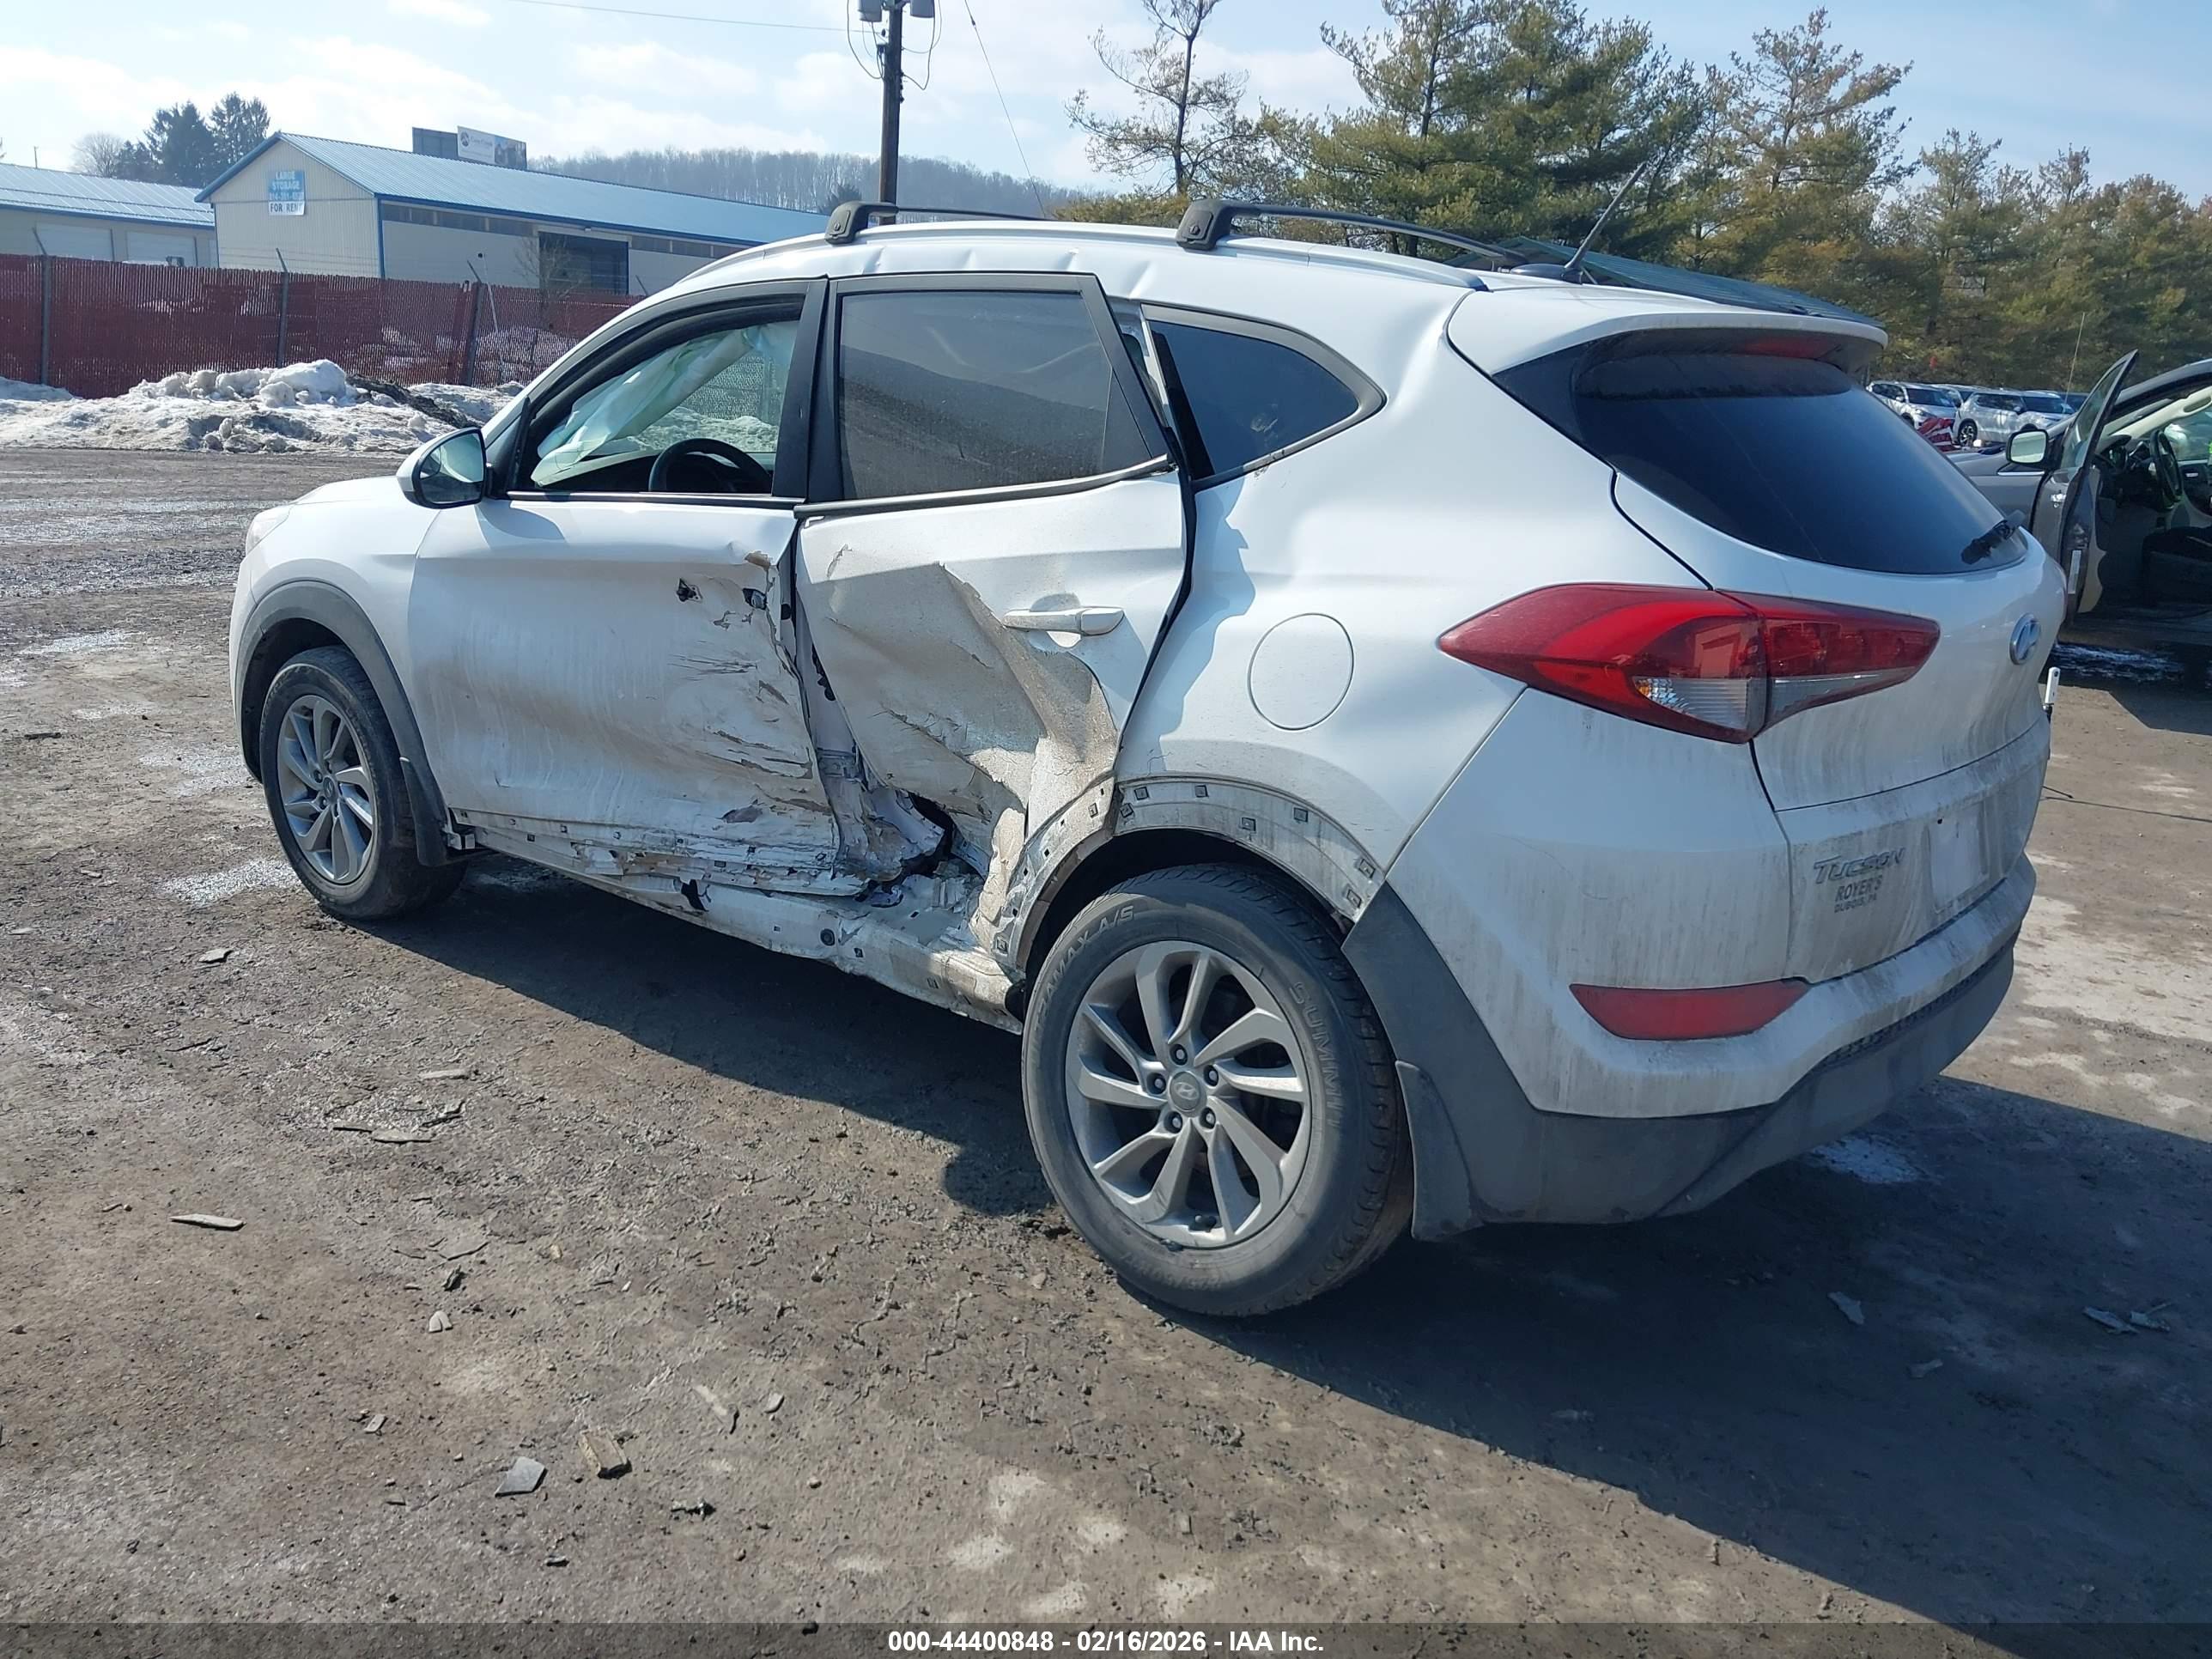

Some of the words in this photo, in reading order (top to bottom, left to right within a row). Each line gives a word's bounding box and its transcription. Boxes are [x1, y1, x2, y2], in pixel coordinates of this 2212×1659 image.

[271, 180, 301, 191] STORAGE
[270, 203, 283, 213] FOR
[286, 203, 302, 213] RENT
[1813, 847, 1905, 884] TUCSON
[1834, 874, 1883, 902] ROYER'S
[1098, 905, 1134, 933] A/S
[1290, 981, 1345, 1127] SUMMIT
